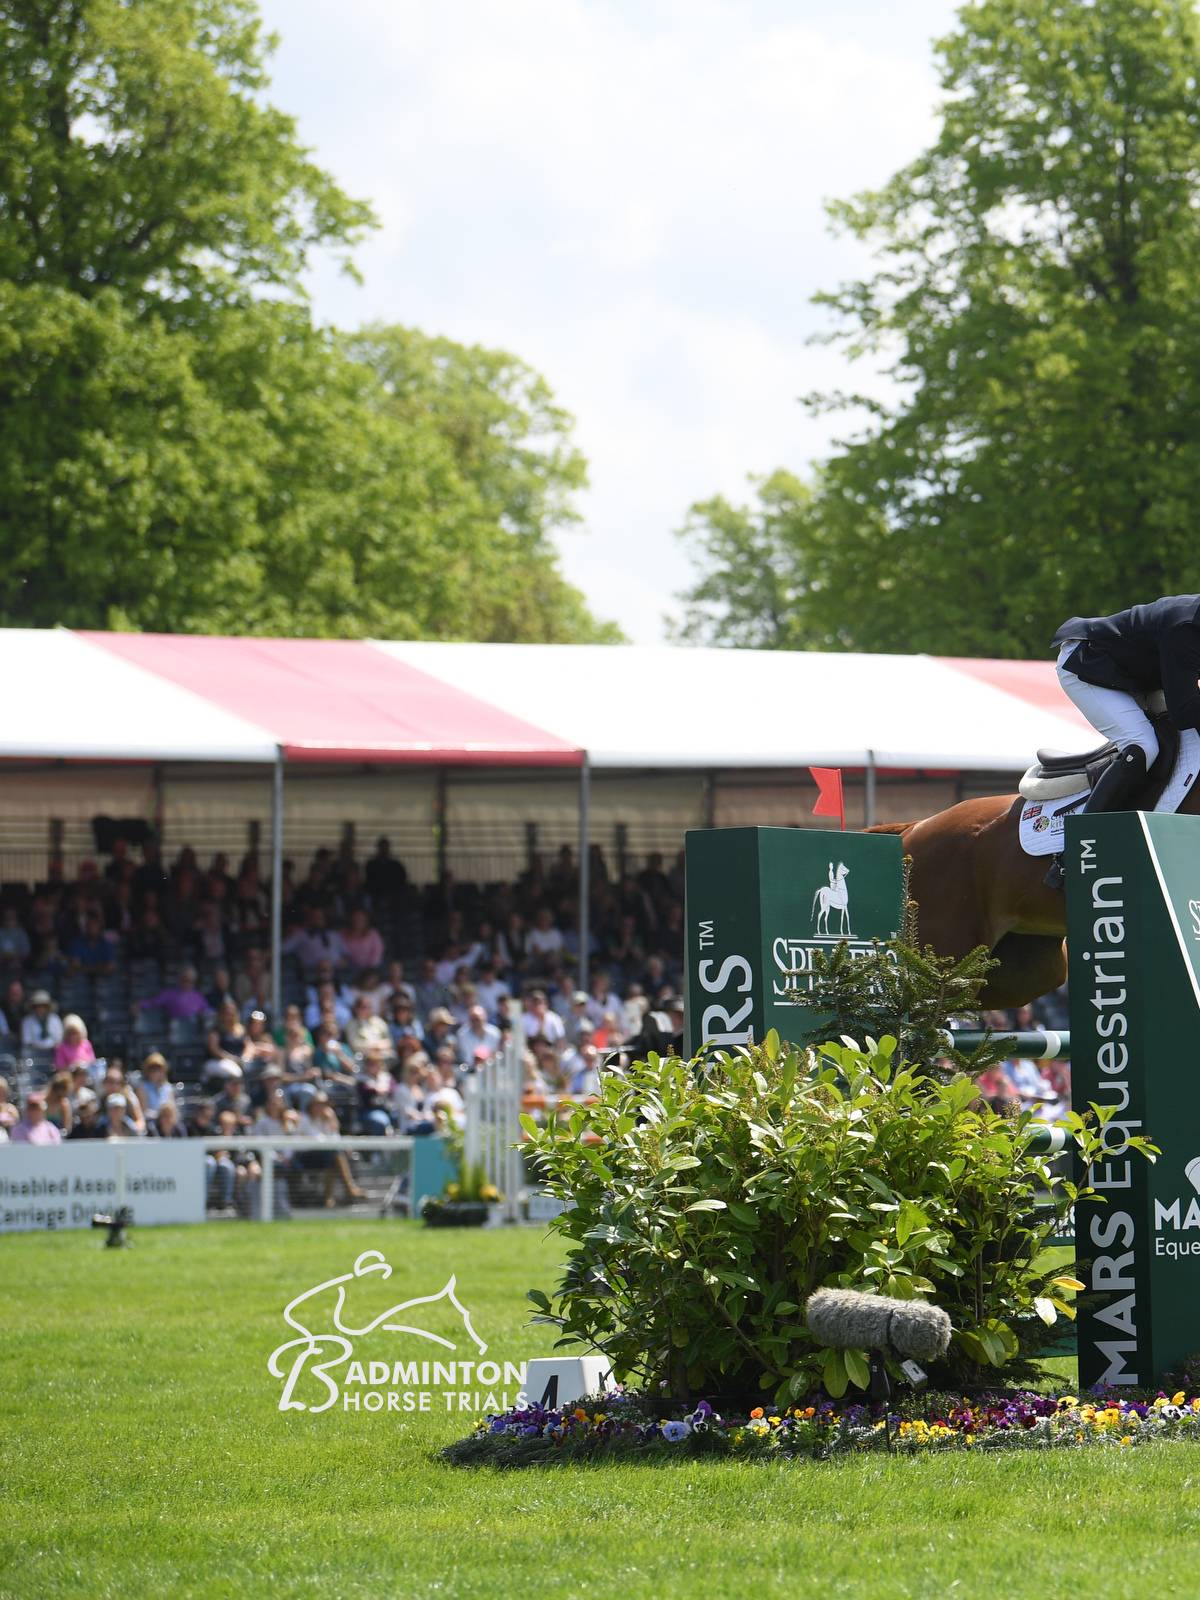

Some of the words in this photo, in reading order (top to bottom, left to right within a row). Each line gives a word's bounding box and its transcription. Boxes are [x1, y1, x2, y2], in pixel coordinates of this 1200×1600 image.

[698, 954, 755, 1052] RS
[0, 1175, 69, 1197] isabled
[74, 1174, 177, 1195] Assoiation
[0, 1203, 66, 1230] arriage
[1090, 1211, 1139, 1385] MARS
